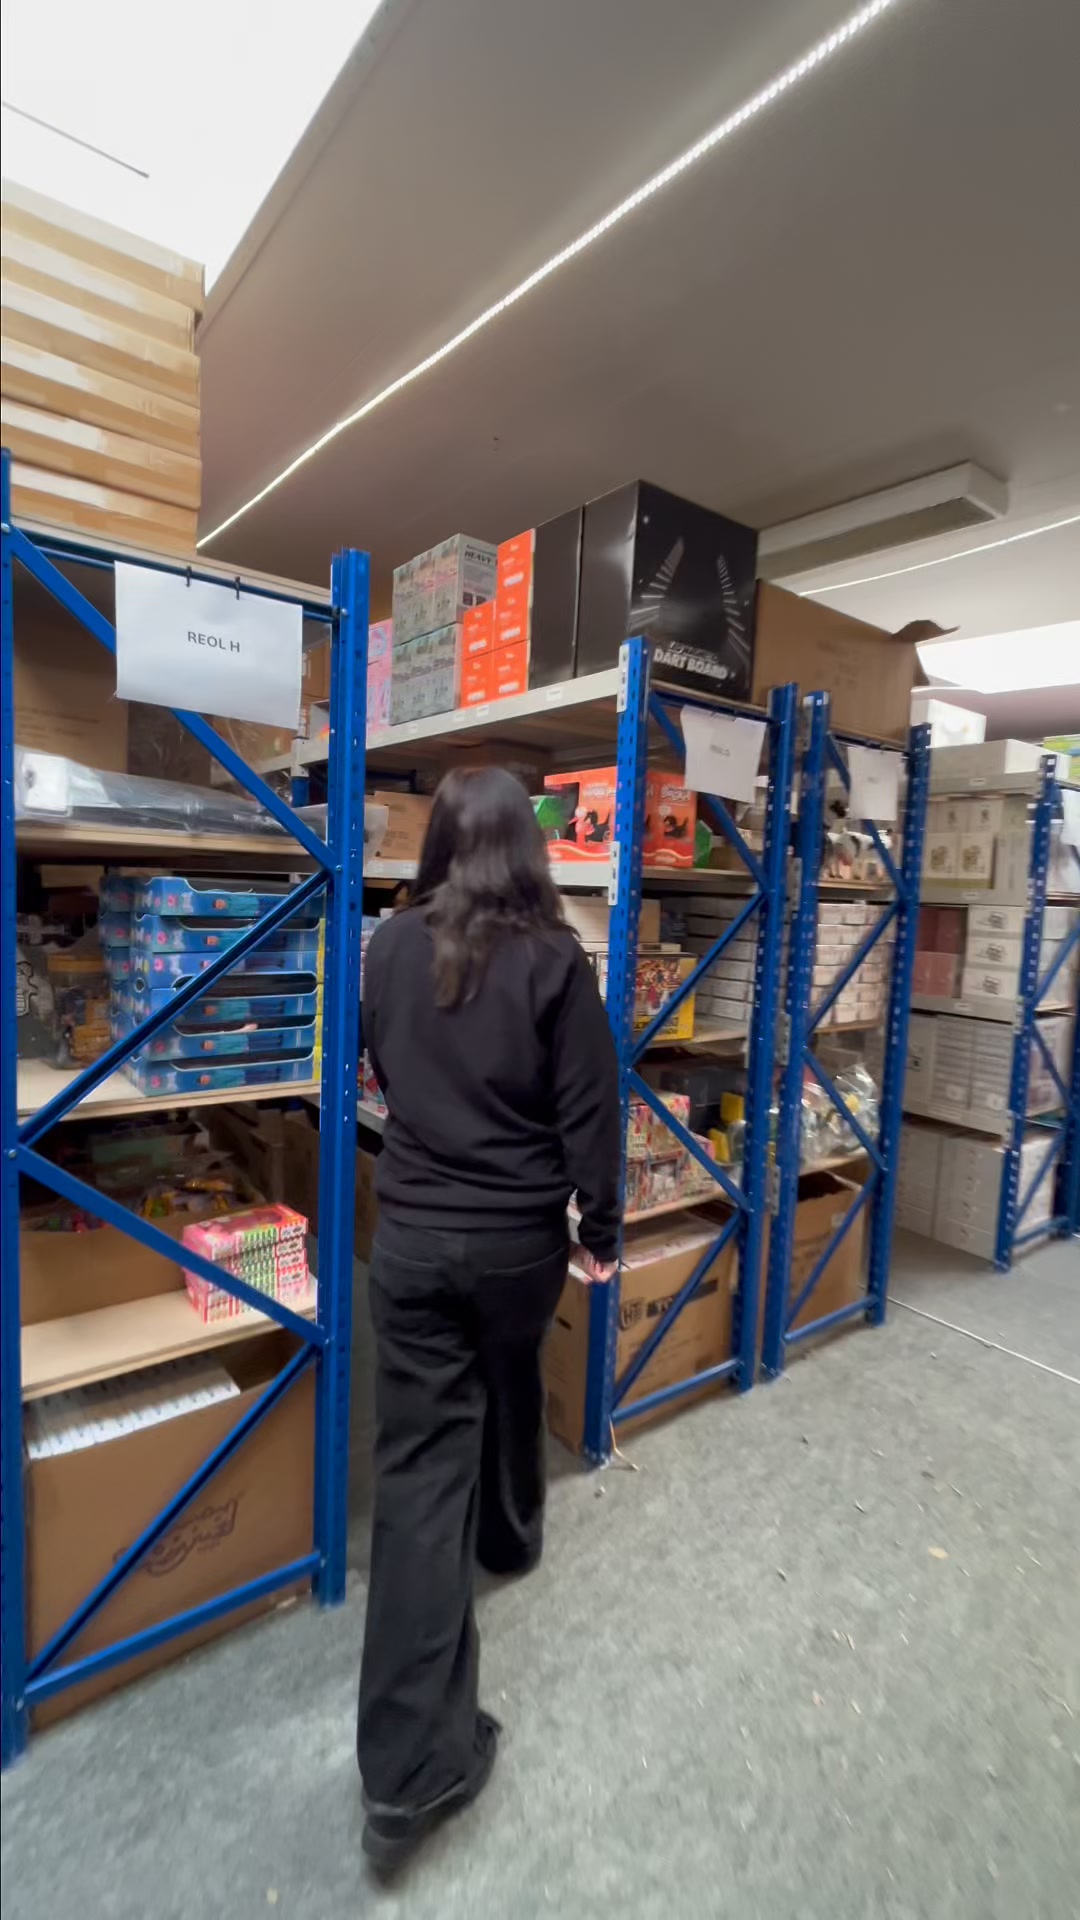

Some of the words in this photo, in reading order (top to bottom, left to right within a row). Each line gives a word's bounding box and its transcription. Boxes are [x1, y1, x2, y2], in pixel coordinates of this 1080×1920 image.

[187, 631, 227, 650] REOL
[230, 640, 241, 653] H
[654, 647, 688, 669] DART
[686, 658, 728, 680] BOARD
